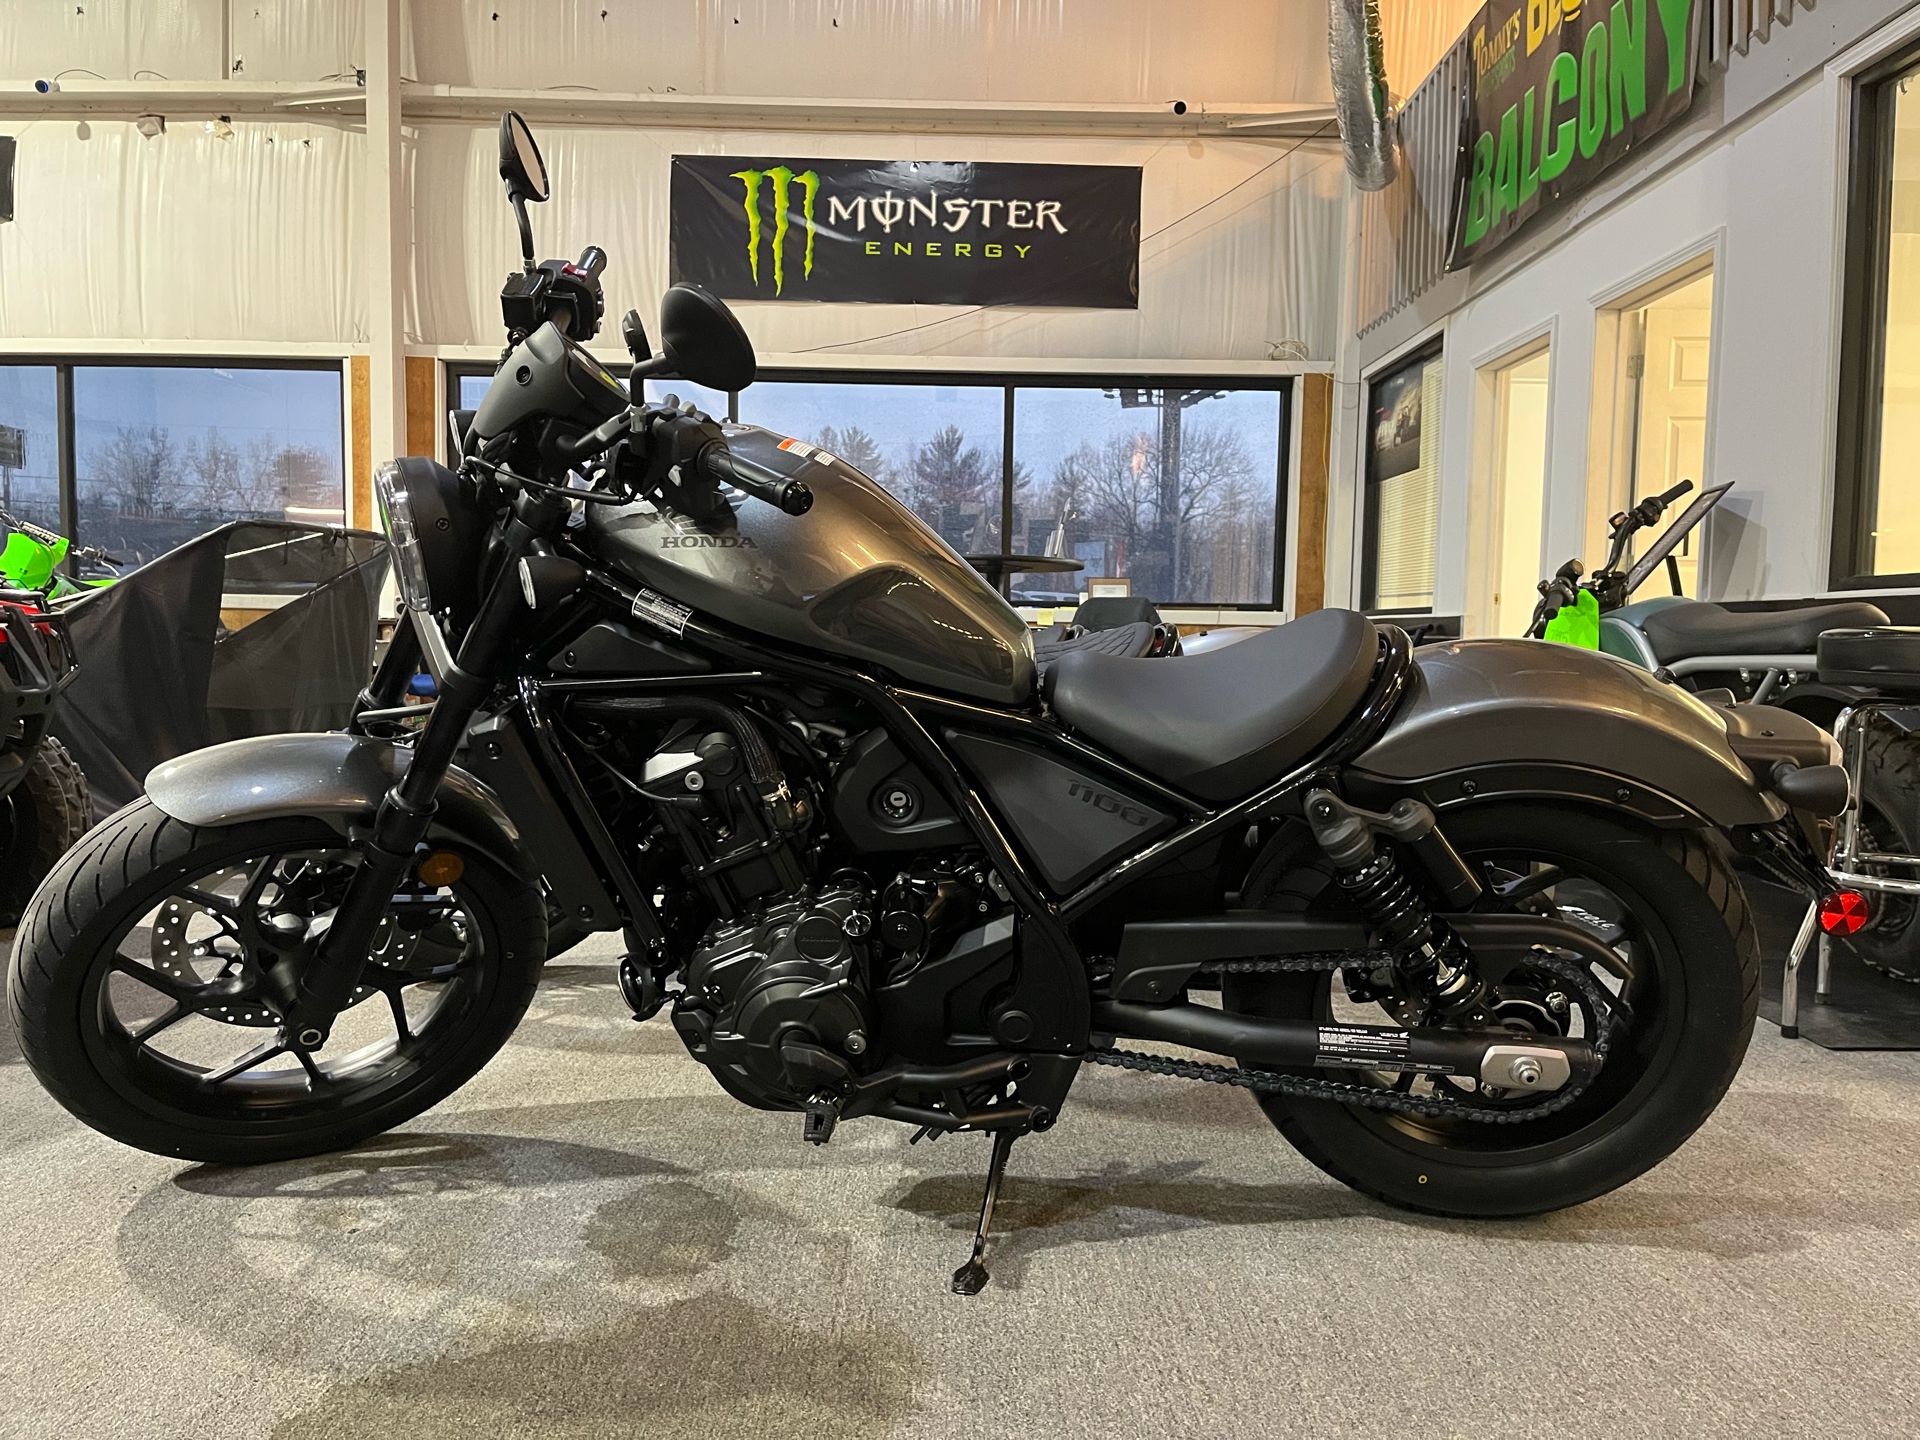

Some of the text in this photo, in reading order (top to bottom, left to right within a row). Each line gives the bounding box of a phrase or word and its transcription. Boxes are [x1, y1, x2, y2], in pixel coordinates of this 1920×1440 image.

[1464, 0, 1691, 248] BALCONY
[827, 191, 1068, 235] MONSTER
[865, 241, 1032, 259] ENERGY
[660, 535, 758, 549] HONDA
